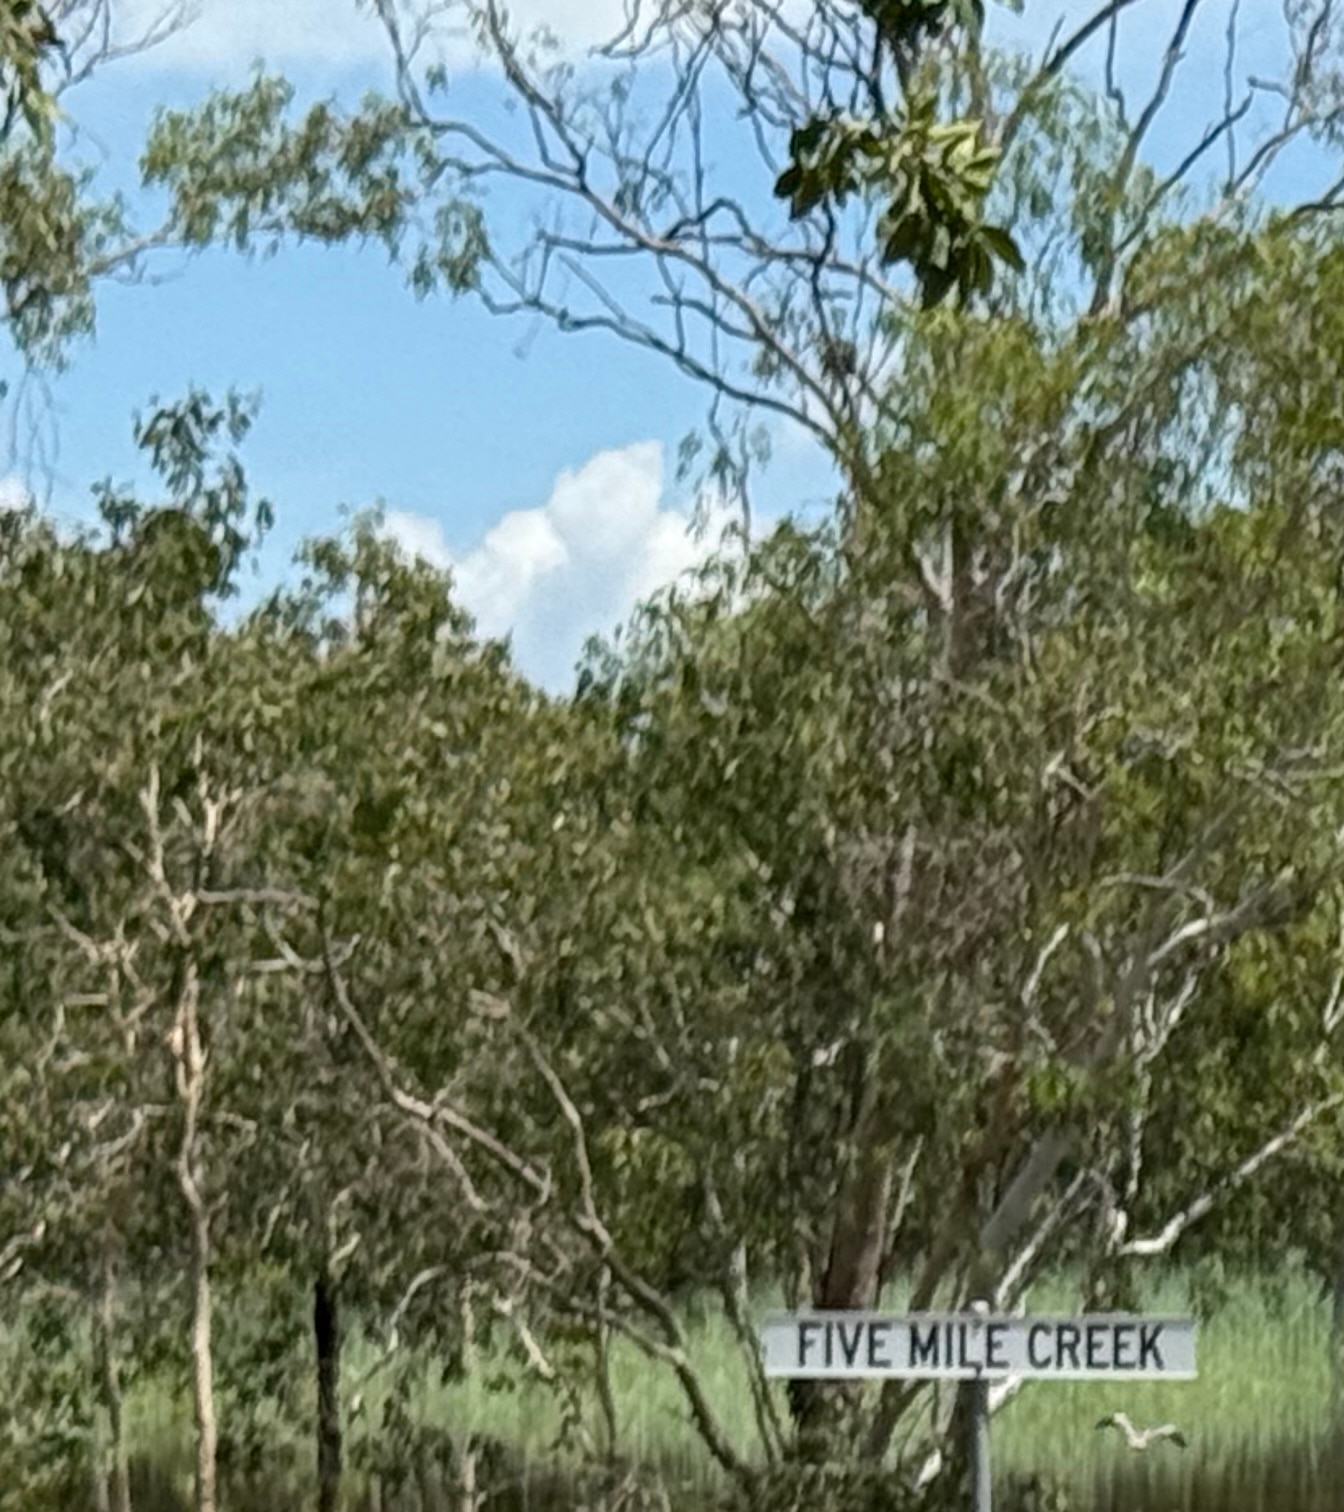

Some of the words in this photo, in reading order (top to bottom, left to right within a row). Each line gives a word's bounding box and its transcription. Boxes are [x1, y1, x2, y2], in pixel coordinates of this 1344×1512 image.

[798, 1321, 892, 1367] FIVE
[909, 1322, 1010, 1368] MILE
[1028, 1322, 1165, 1369] CREEK
